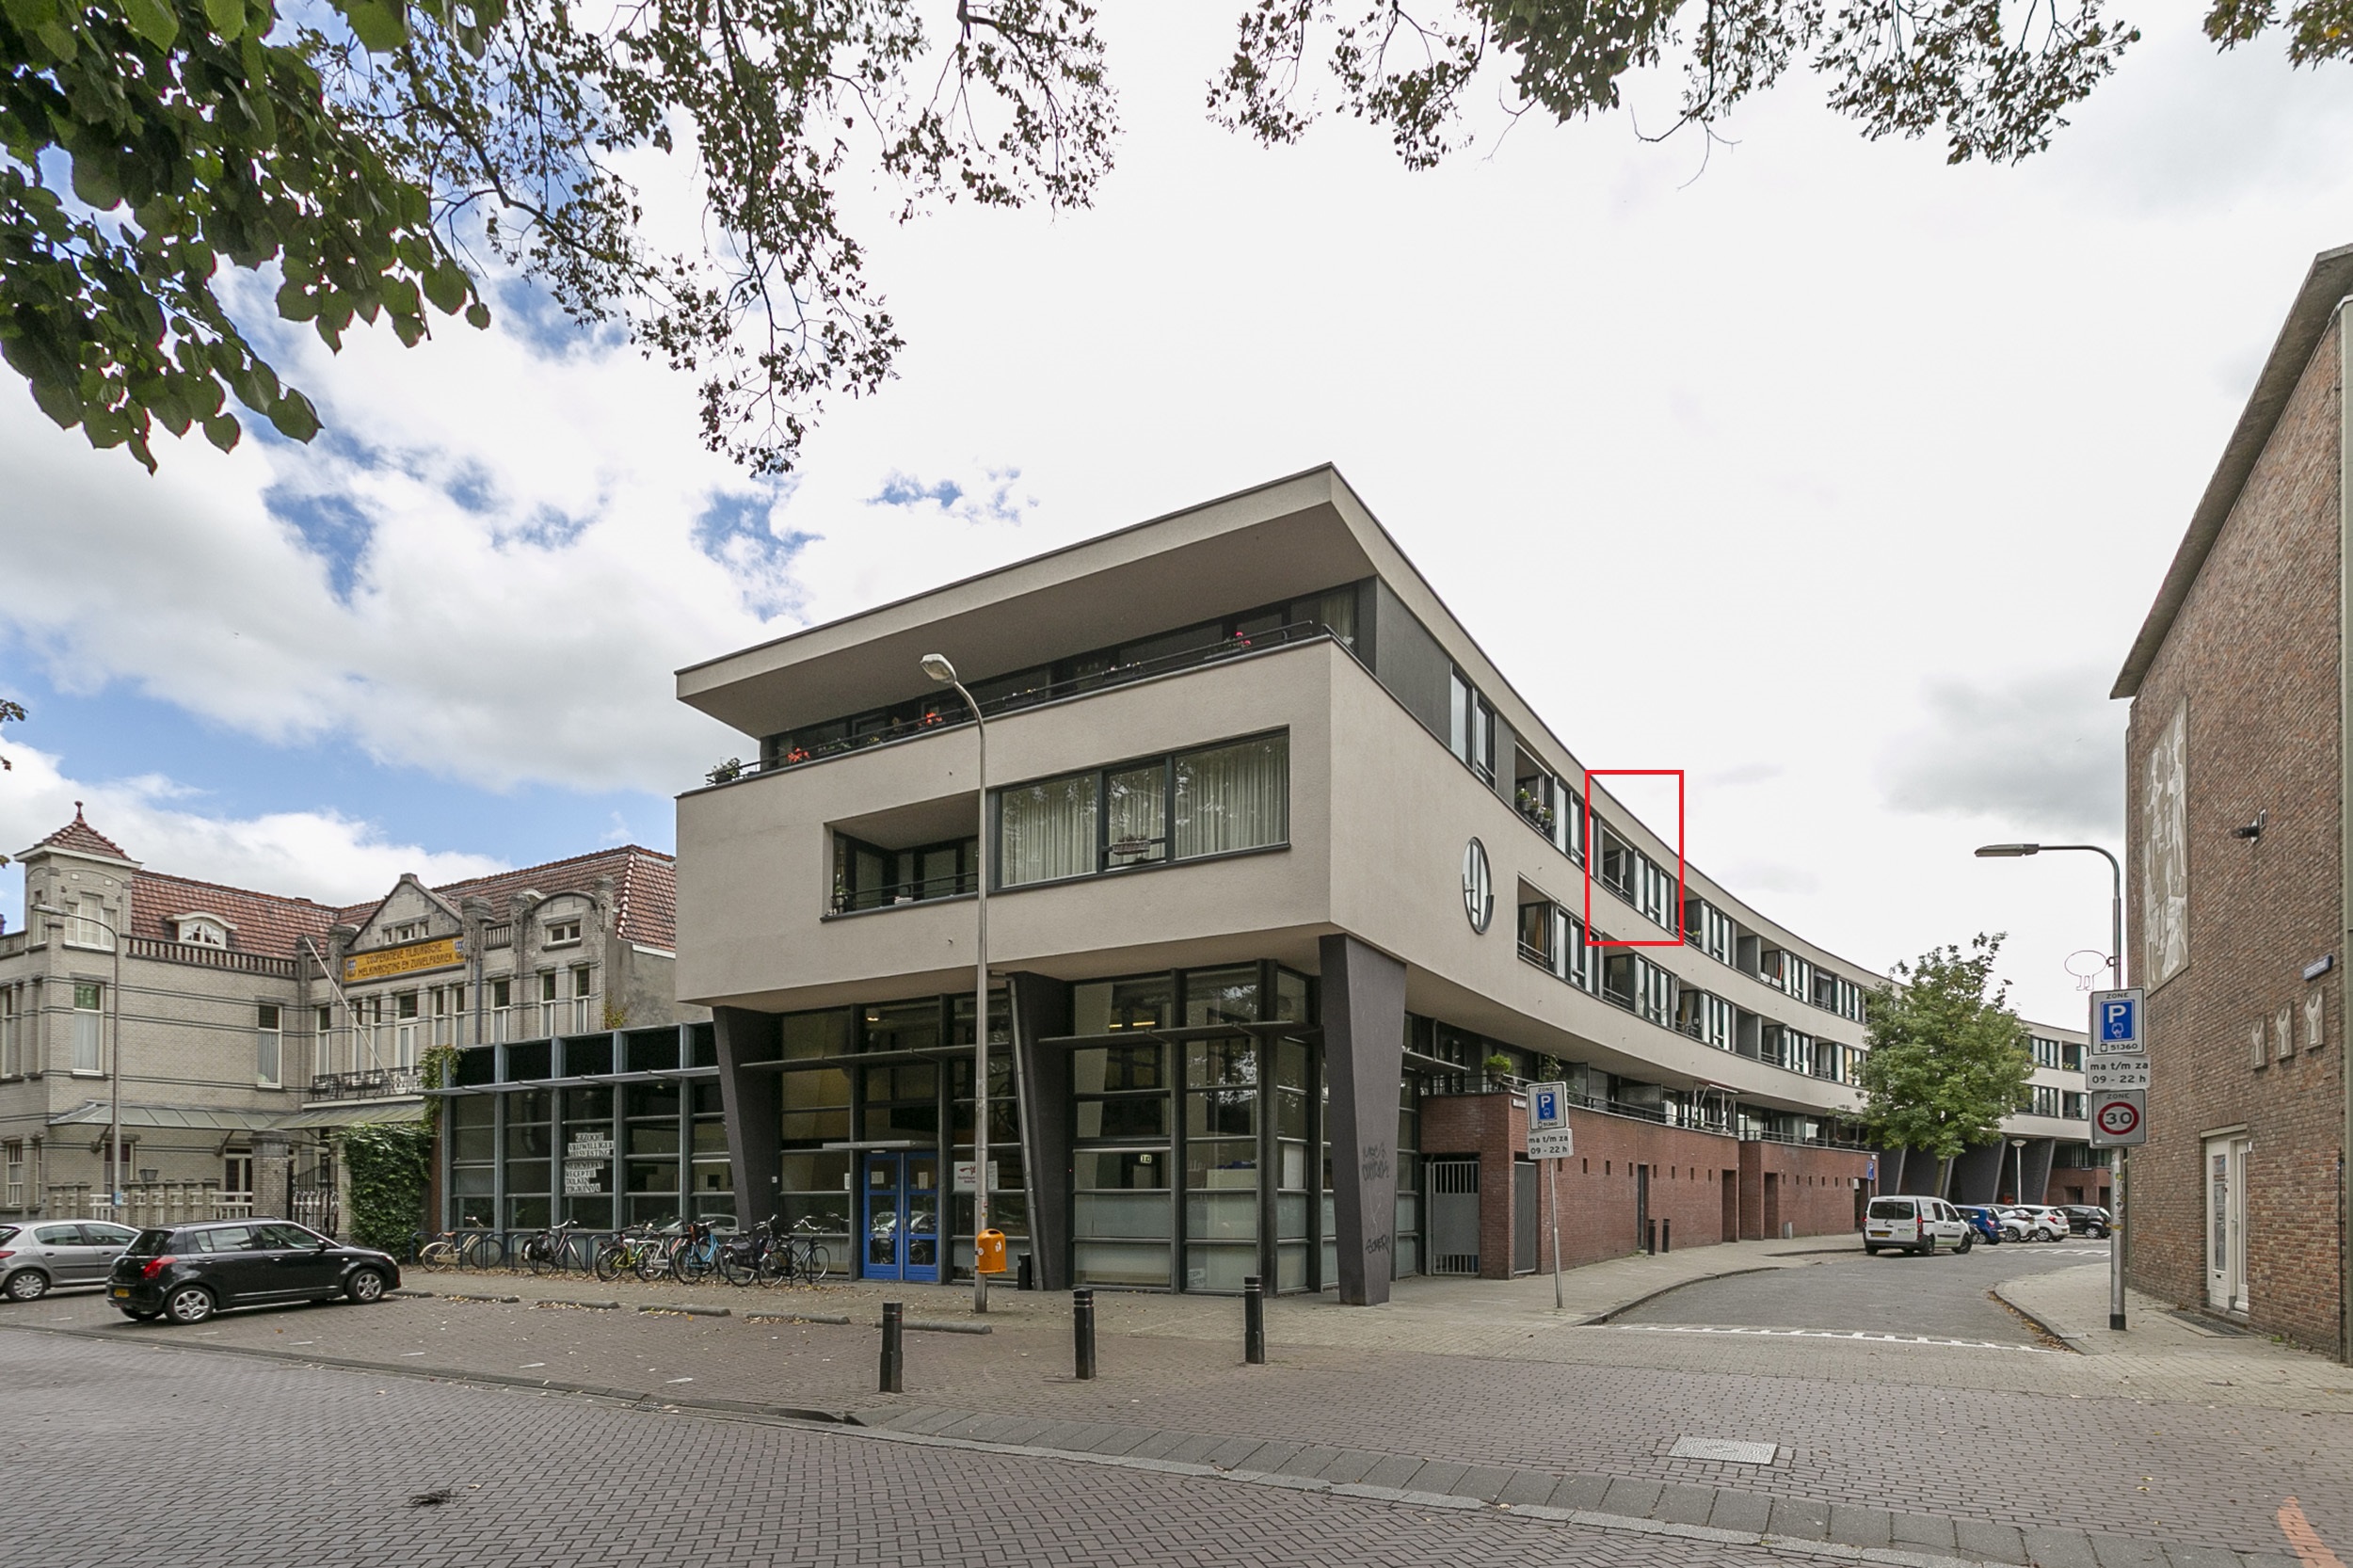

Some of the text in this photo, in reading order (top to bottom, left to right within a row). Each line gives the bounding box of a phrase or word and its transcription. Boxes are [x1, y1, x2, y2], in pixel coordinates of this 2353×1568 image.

[2108, 1004, 2126, 1023] P
[2090, 1063, 2106, 1071] ma
[2110, 1061, 2131, 1071] t/m
[2092, 1075, 2106, 1083] 09
[2120, 1075, 2135, 1083] 22
[2139, 1074, 2146, 1082] h
[1541, 1096, 1551, 1108] P
[2105, 1112, 2133, 1125] 30
[1543, 1135, 1557, 1144] t/m
